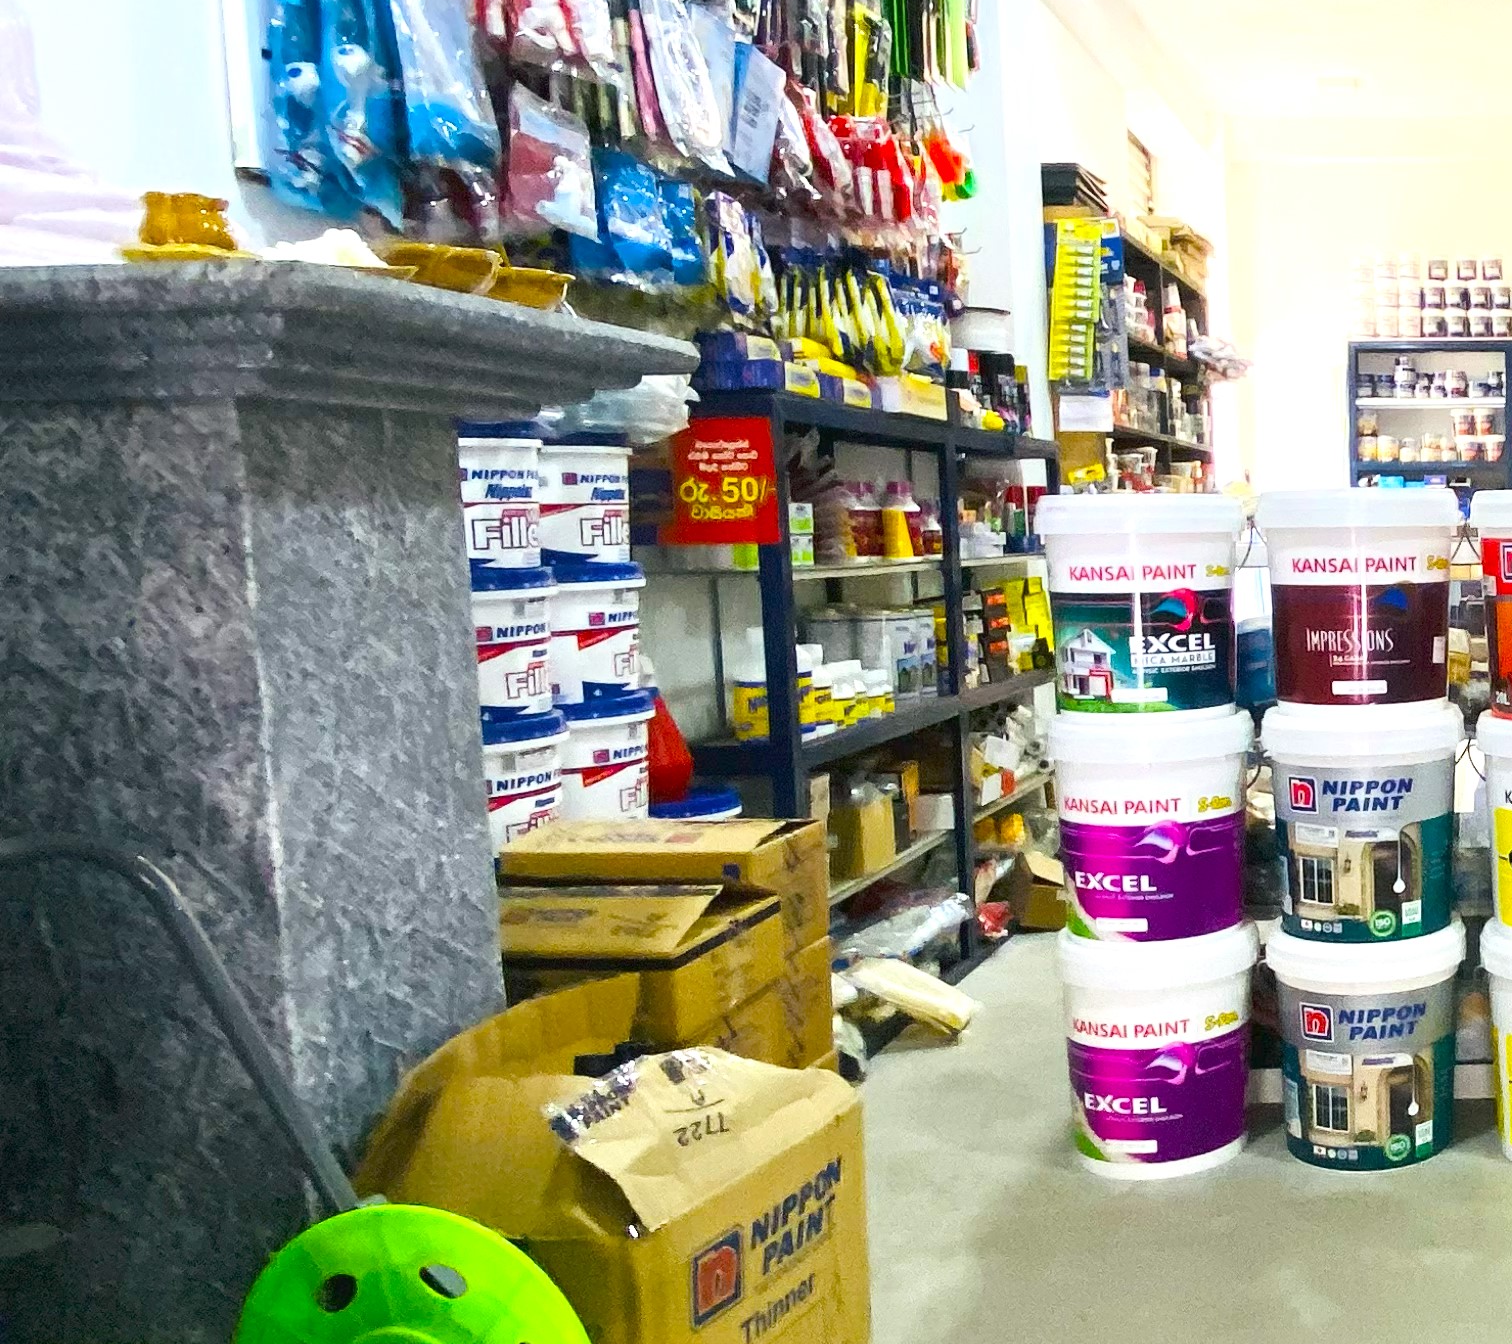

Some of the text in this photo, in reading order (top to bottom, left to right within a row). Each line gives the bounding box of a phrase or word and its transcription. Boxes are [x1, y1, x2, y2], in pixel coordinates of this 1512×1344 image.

[472, 469, 524, 480] NIPPON
[472, 516, 540, 550] Fille
[1069, 564, 1134, 581] KANSAI
[1142, 564, 1197, 581] PAINT
[1292, 558, 1358, 573] KANSAI
[1365, 556, 1417, 572] PAINT
[608, 611, 638, 623] NIPP
[496, 623, 546, 639] NIPPON
[1306, 627, 1394, 653] IMPRESSONS
[1129, 632, 1215, 654] EXCEL
[1171, 652, 1214, 664] MARBLE
[612, 745, 644, 760] NIPP
[496, 771, 551, 792] NIPPON
[1322, 778, 1414, 795] NIPPON
[1064, 796, 1118, 814] KANSAI
[1124, 798, 1181, 814] PAINT
[1332, 795, 1405, 812] PAINT
[1075, 871, 1157, 892] EXCEL
[1338, 1001, 1427, 1025] NIPPON
[1073, 1018, 1127, 1038] KANSAI
[1134, 1018, 1190, 1038] PAINT
[1349, 1020, 1418, 1041] PAINT
[1084, 1092, 1168, 1114] EXCEL
[751, 1156, 843, 1250] NIPPON
[762, 1194, 835, 1276] PAINT
[740, 1273, 816, 1344] Thinner
